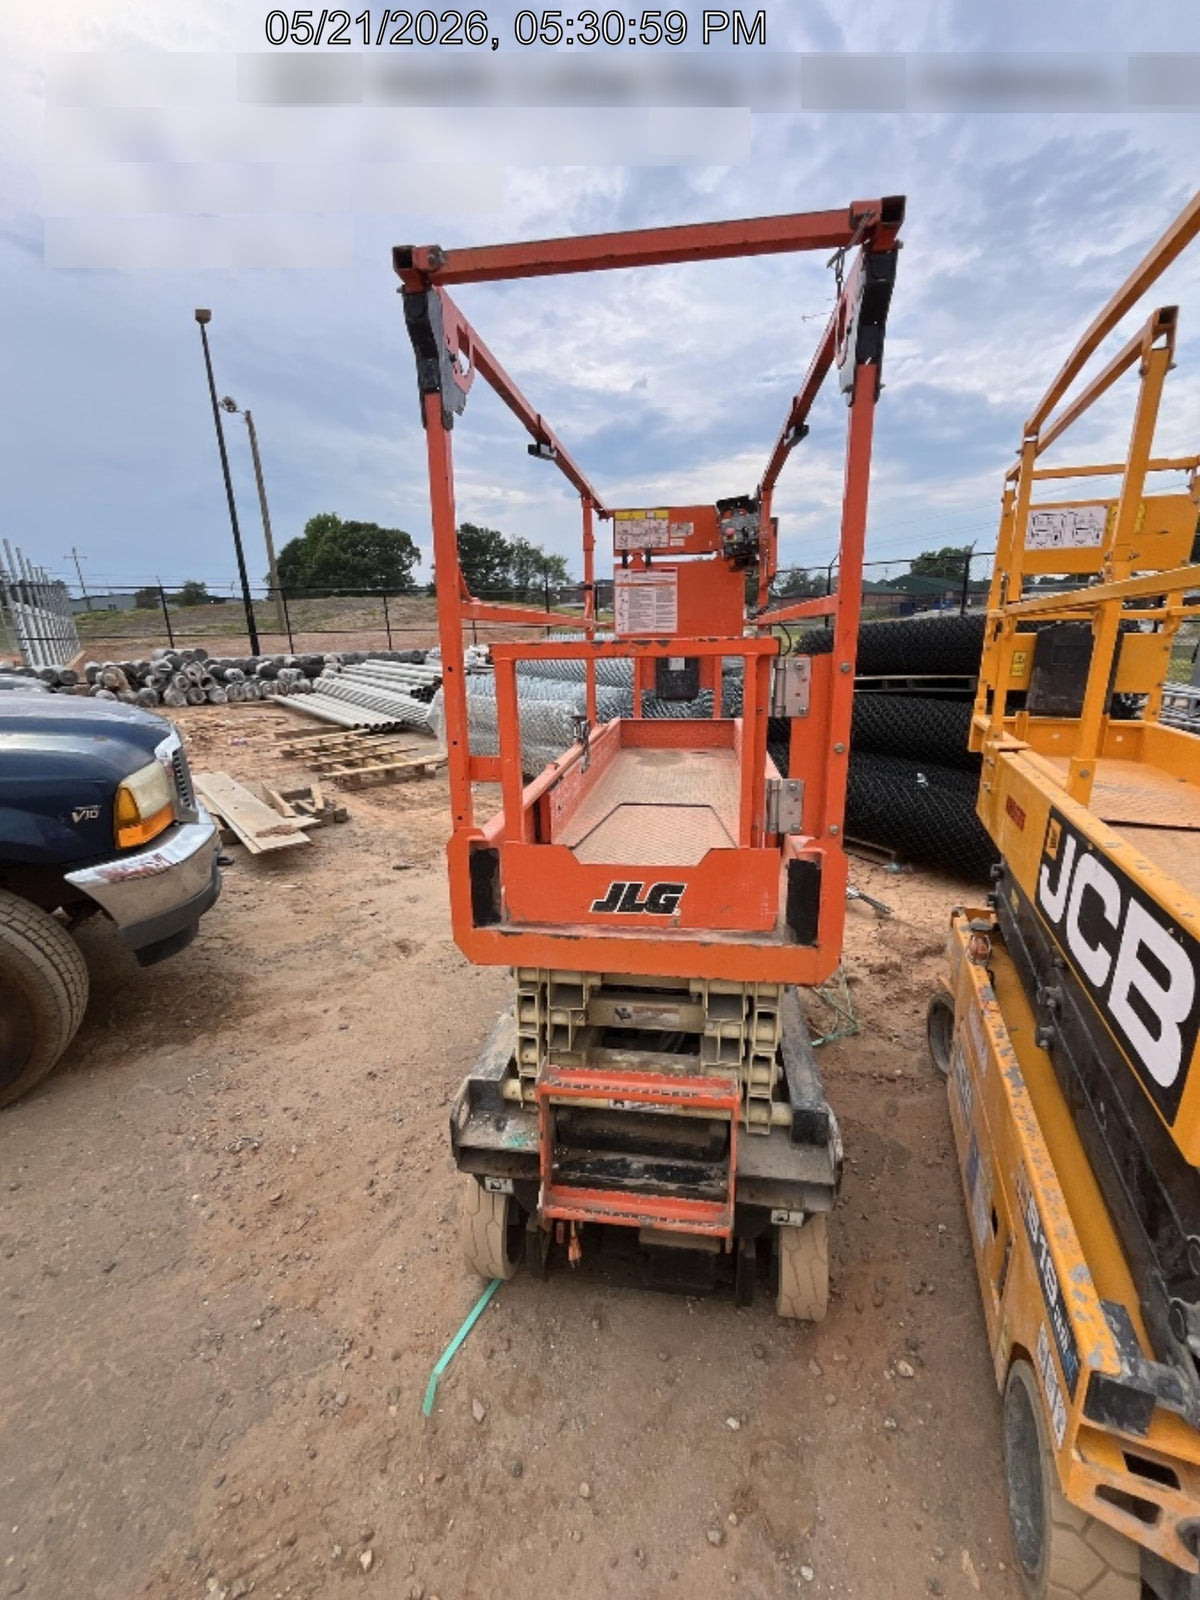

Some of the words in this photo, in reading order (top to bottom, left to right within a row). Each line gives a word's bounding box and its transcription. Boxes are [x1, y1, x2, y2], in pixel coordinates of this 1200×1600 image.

[71, 809, 99, 823] V10
[588, 881, 688, 916] JLG
[1040, 834, 1195, 1087] JCB
